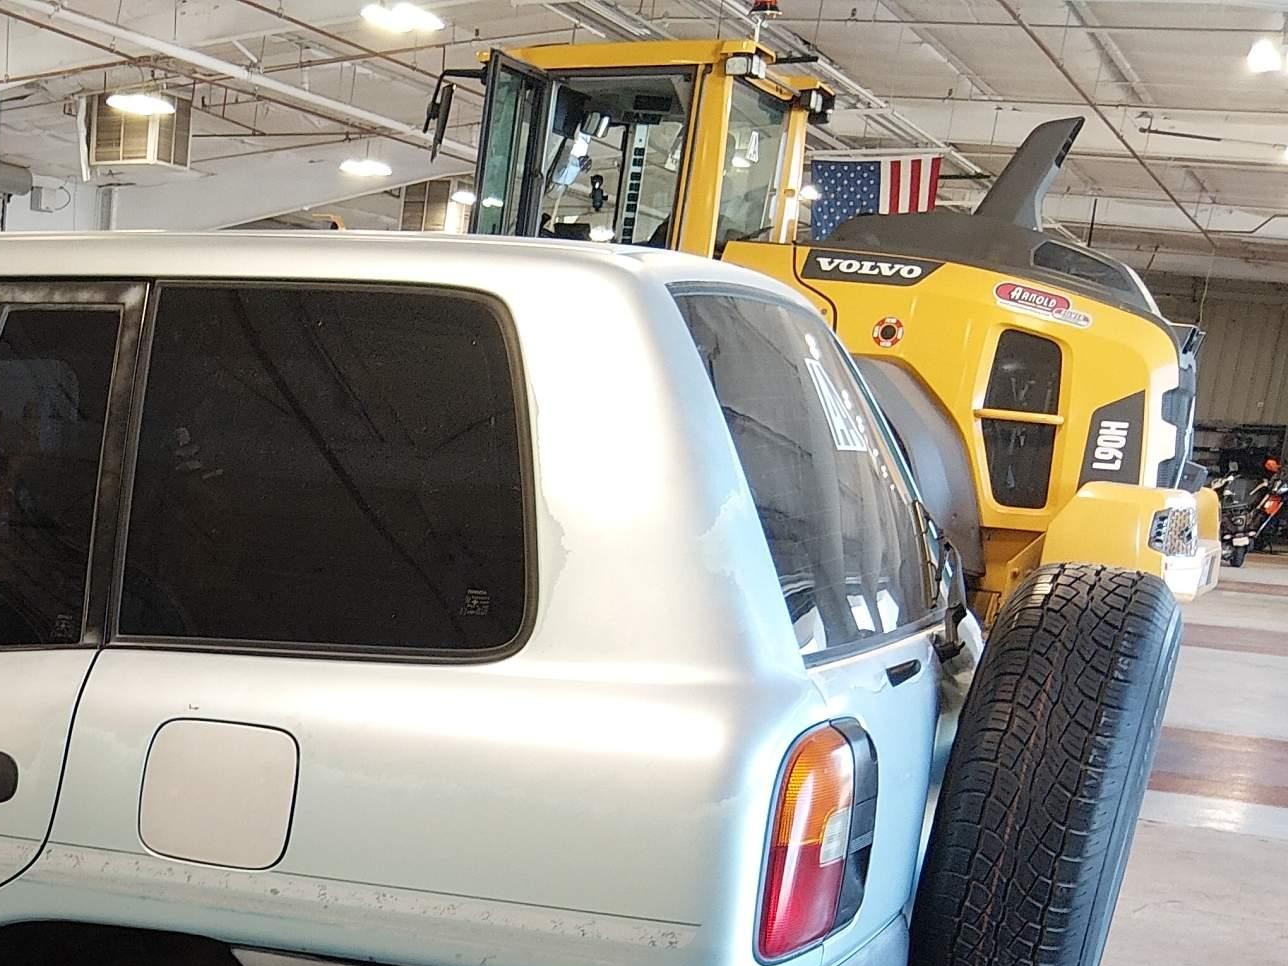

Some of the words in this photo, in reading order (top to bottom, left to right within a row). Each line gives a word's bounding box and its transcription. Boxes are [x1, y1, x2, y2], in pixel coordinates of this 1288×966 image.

[816, 257, 922, 278] VOLVO
[1010, 286, 1057, 308] ARNOLD
[1092, 420, 1130, 471] L90H
